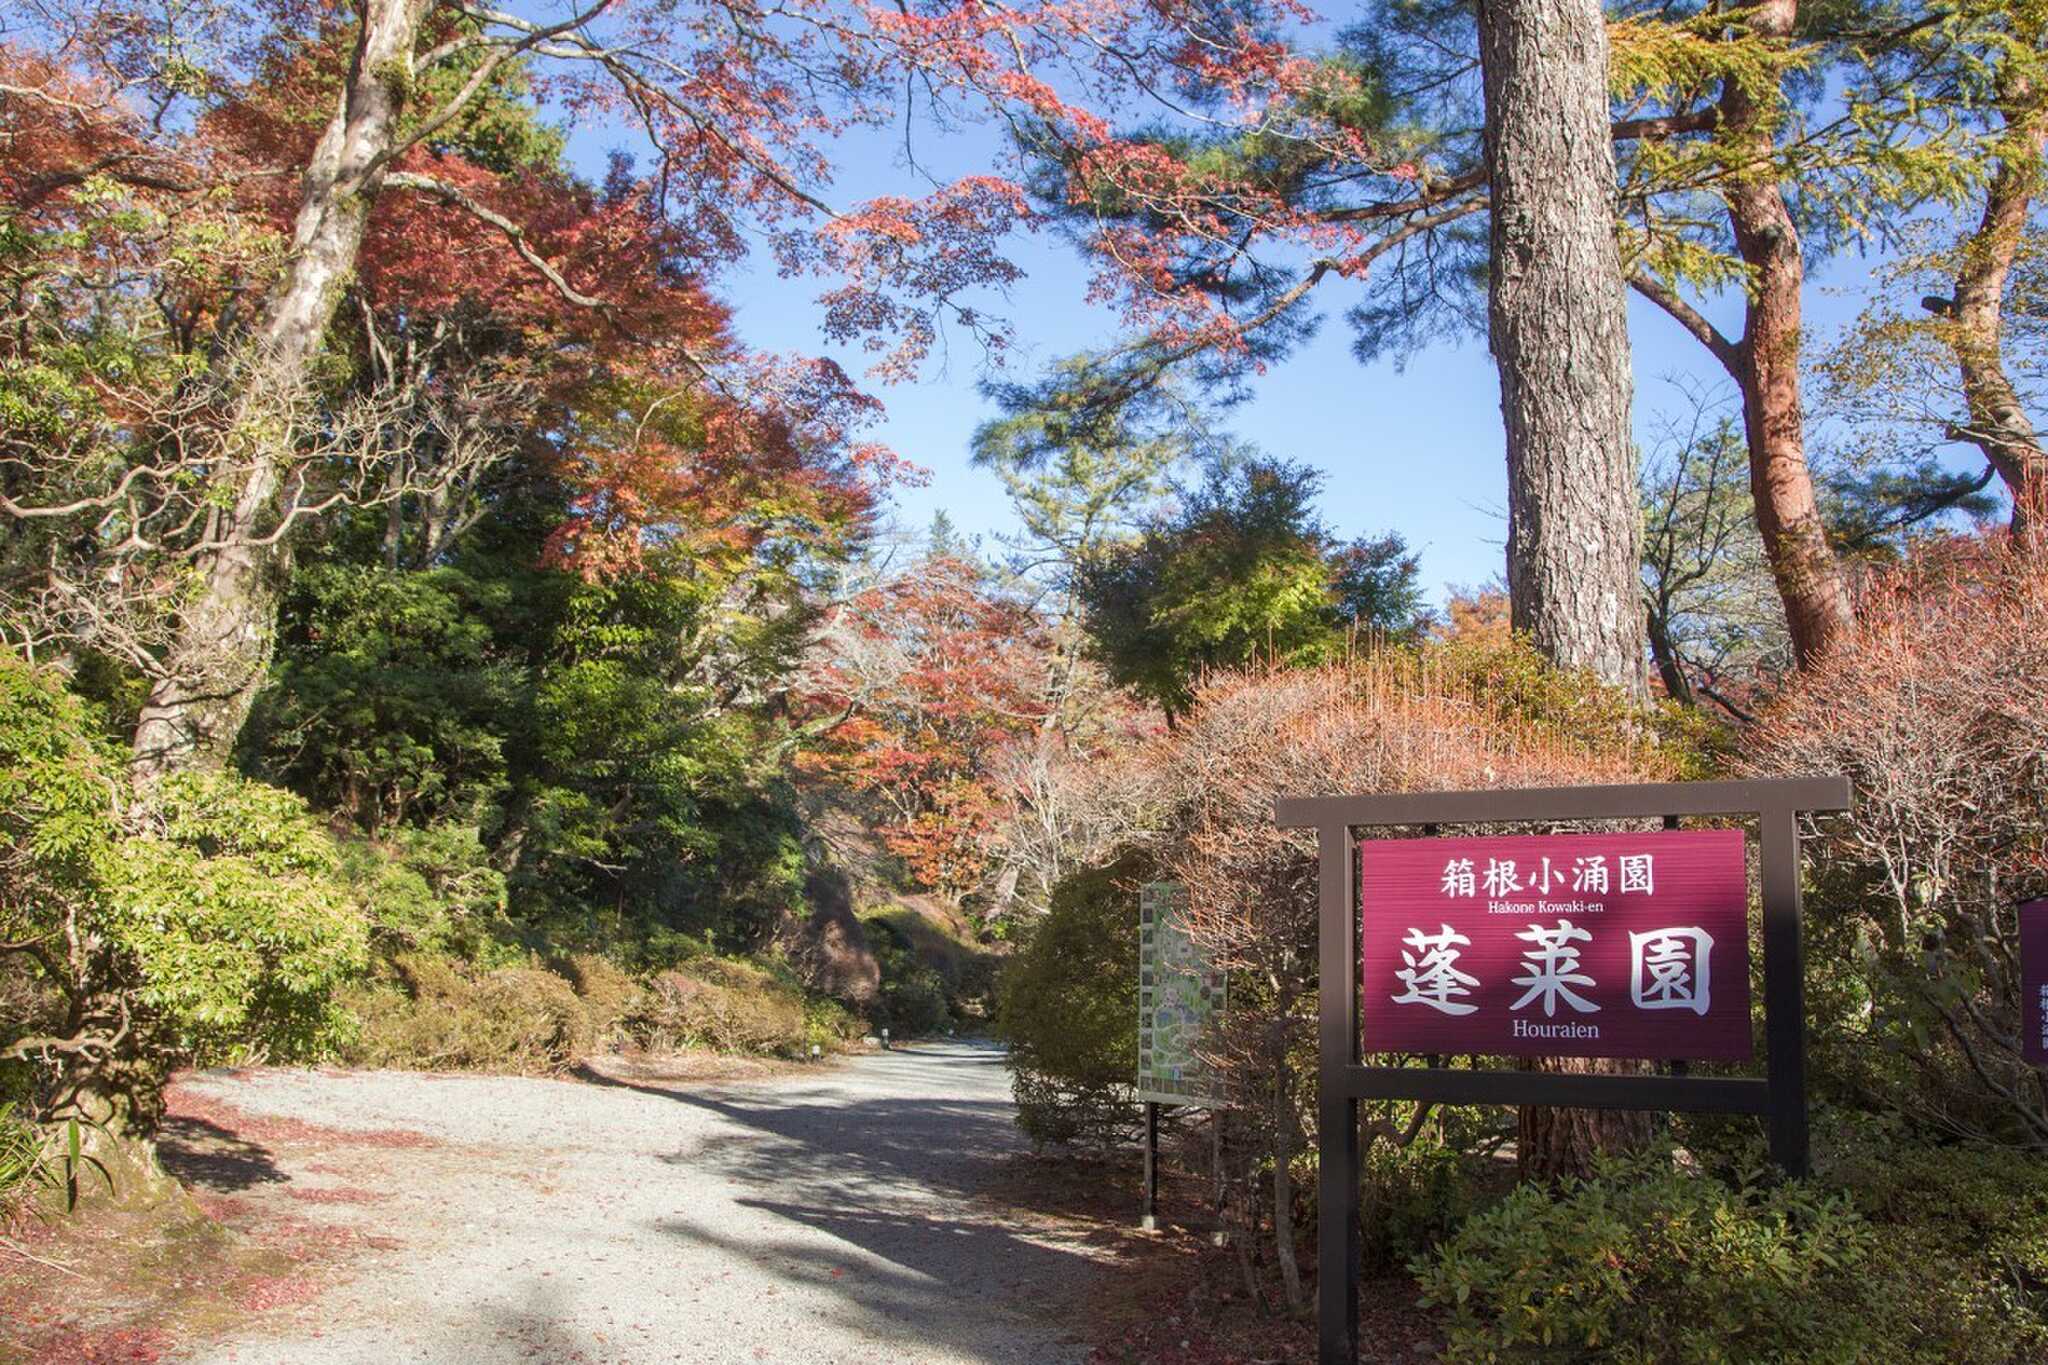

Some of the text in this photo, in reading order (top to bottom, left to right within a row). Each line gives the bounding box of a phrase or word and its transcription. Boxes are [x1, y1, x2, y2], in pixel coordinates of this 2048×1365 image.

[1441, 854, 1654, 898] 箱根小涌園
[1488, 900, 1604, 914] Hakone Kowaki-en
[1391, 919, 1714, 1016] 蓬莱園
[1513, 1019, 1600, 1038] Houraien
